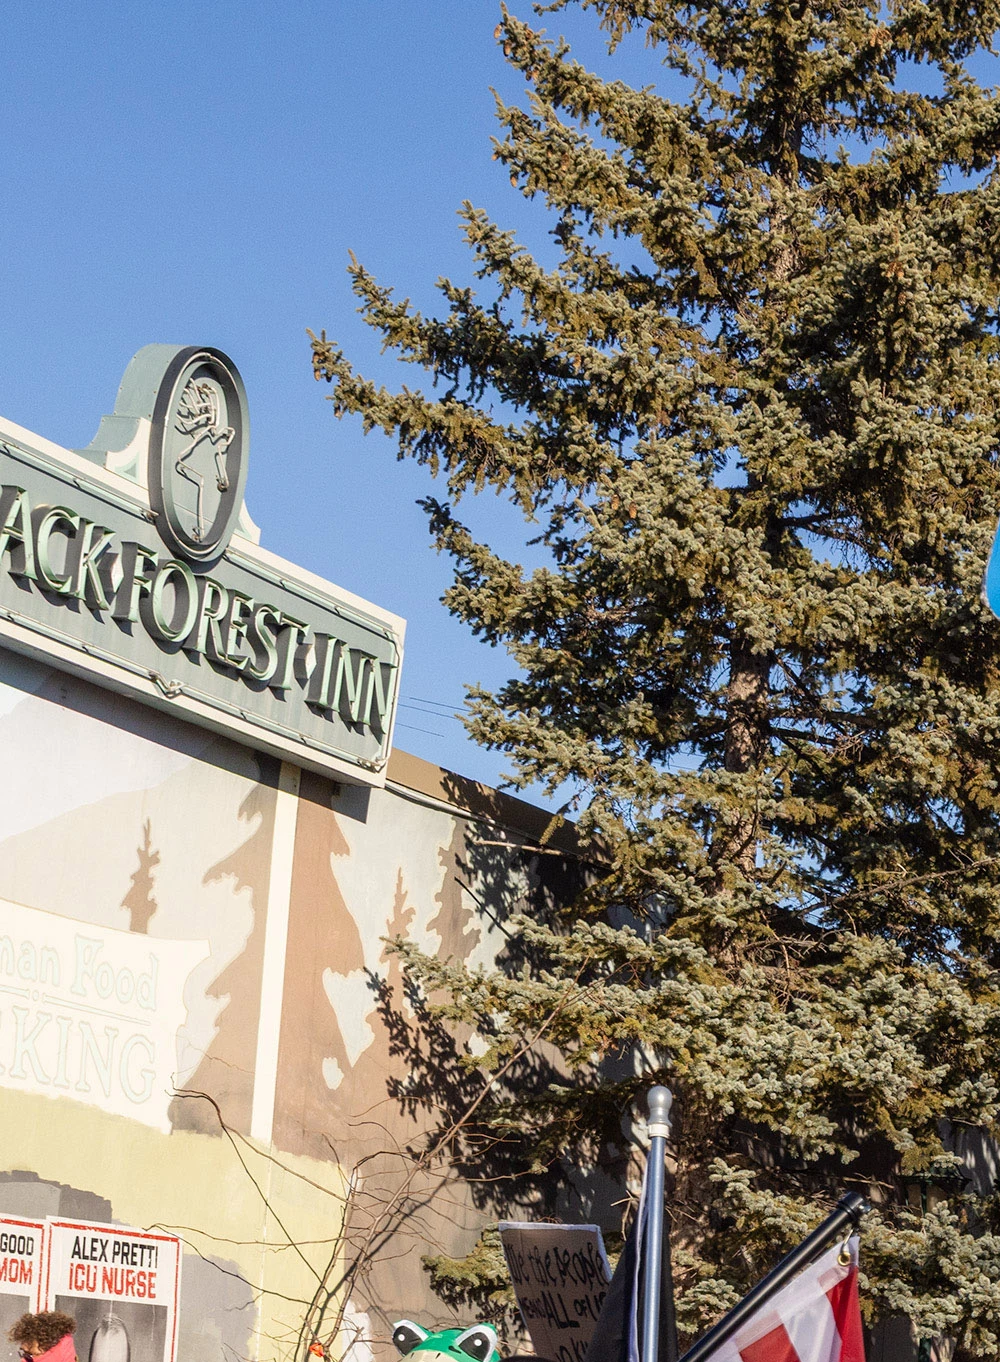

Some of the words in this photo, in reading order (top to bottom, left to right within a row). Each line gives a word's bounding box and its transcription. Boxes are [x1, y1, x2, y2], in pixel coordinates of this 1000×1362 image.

[114, 541, 309, 690] FOREST
[308, 631, 397, 734] INN
[70, 932, 160, 1012] Food
[0, 1004, 156, 1105] KING
[0, 1233, 35, 1256] GOOD
[71, 1235, 109, 1263] ALEX
[112, 1240, 159, 1269] PRETTI
[69, 1263, 97, 1293] ICU
[102, 1266, 157, 1299] NURSE
[541, 1290, 580, 1329] ALL
